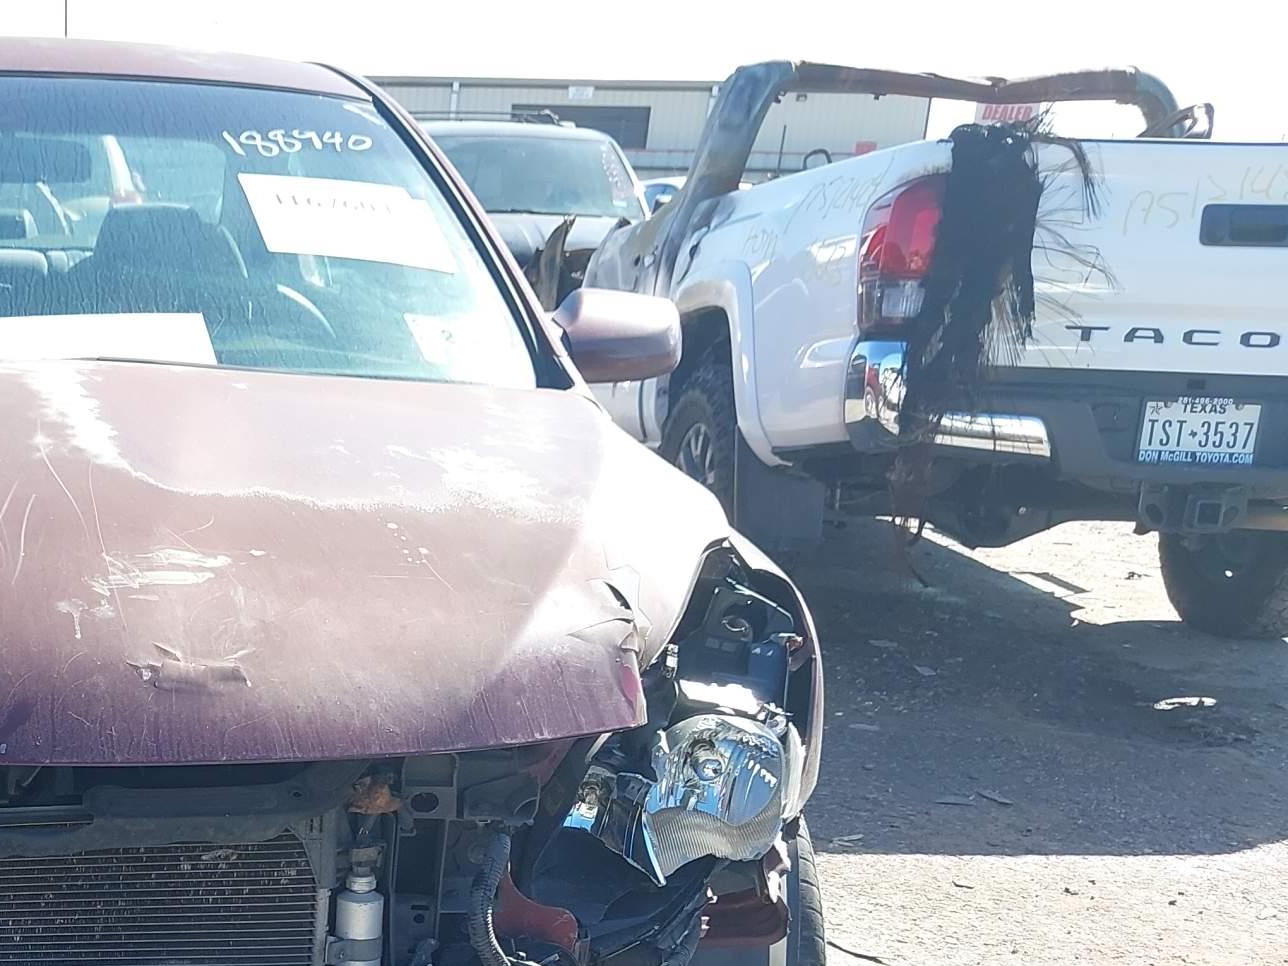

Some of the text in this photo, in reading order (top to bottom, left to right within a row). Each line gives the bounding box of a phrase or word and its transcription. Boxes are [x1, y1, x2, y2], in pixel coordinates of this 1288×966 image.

[983, 104, 1033, 120] DEALER
[1183, 402, 1227, 415] TEXAS
[1138, 450, 1159, 463] DON
[1196, 452, 1255, 465] TOYOTA.COM
